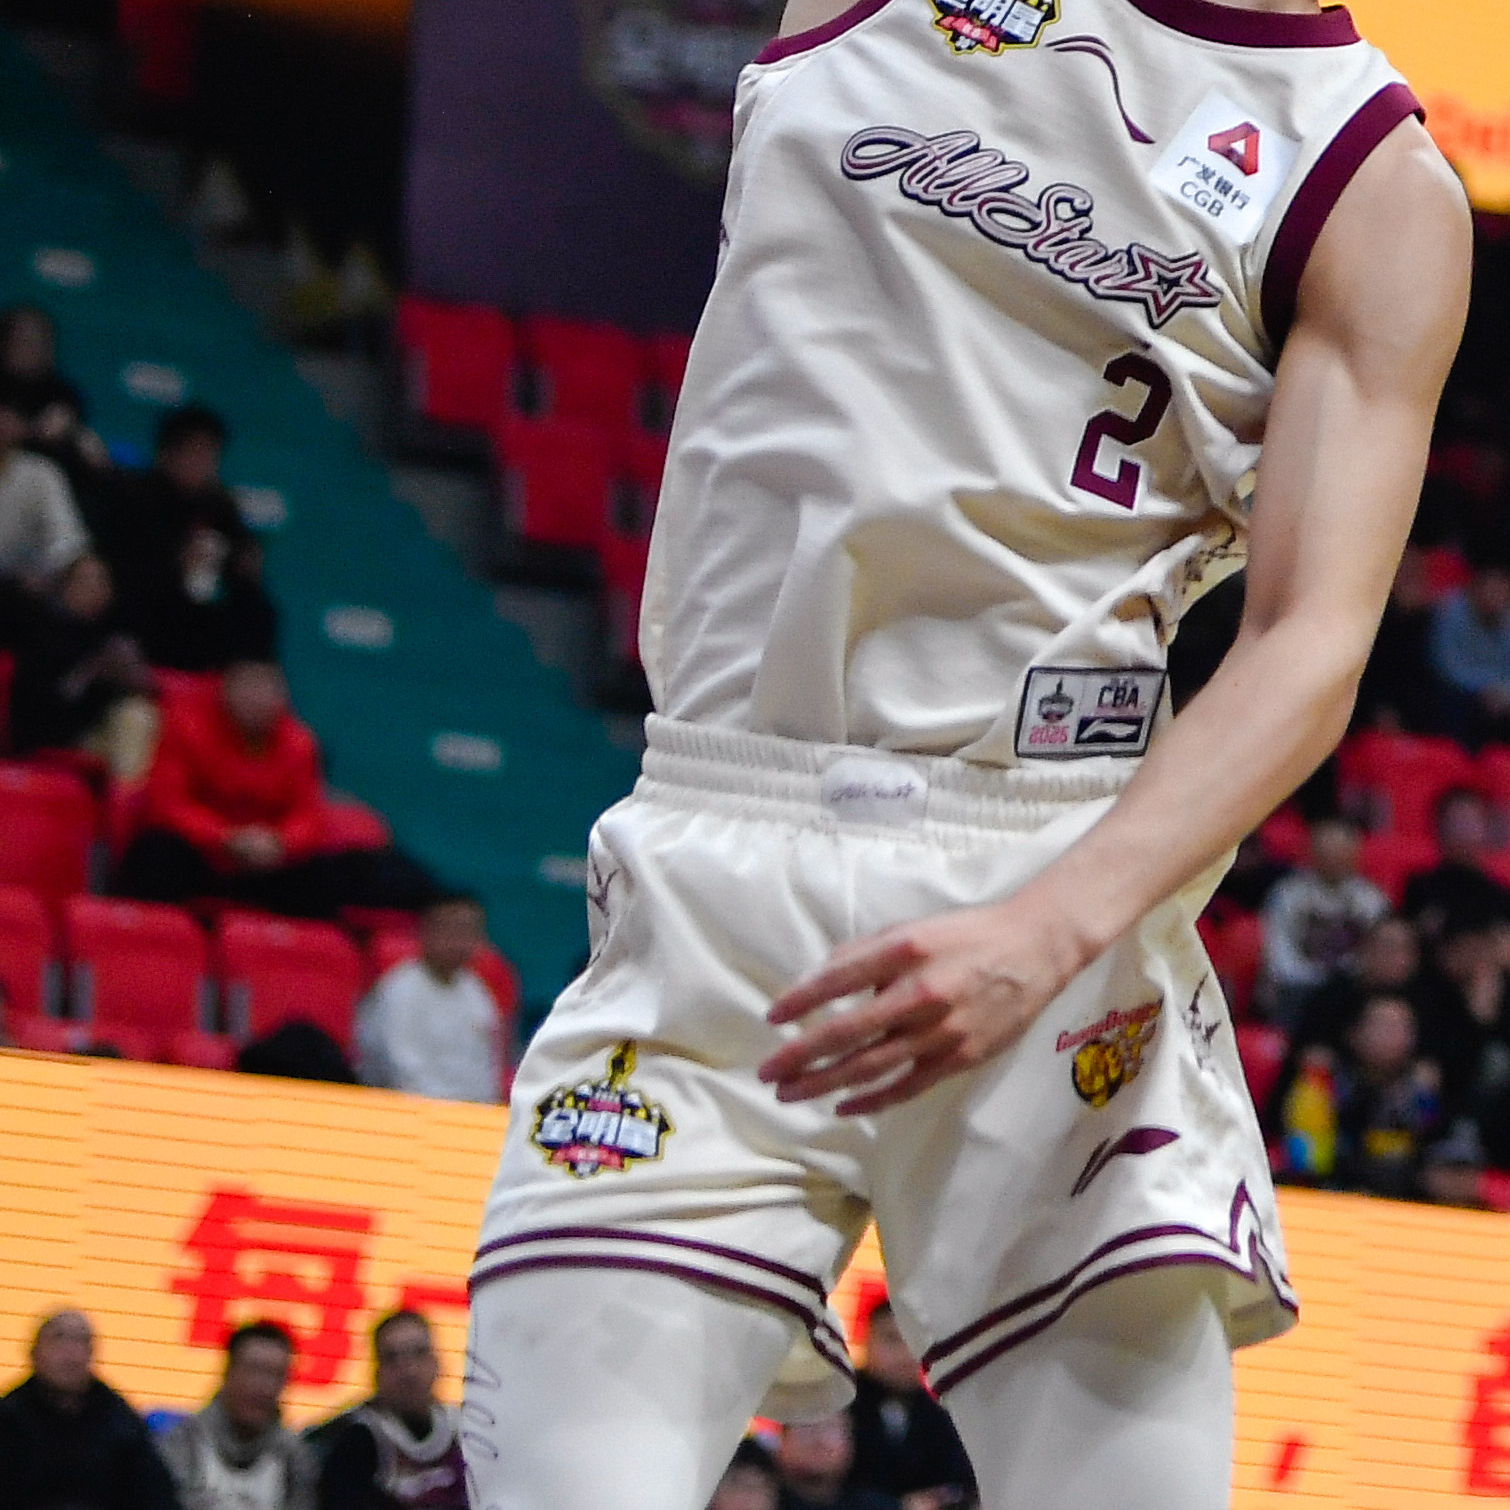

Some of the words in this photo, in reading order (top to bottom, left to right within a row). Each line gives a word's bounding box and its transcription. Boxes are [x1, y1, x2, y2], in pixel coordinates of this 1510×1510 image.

[1177, 154, 1251, 211] 广发银行
[1180, 180, 1225, 218] CGB
[1070, 351, 1174, 512] 2
[1096, 683, 1141, 709] CBA
